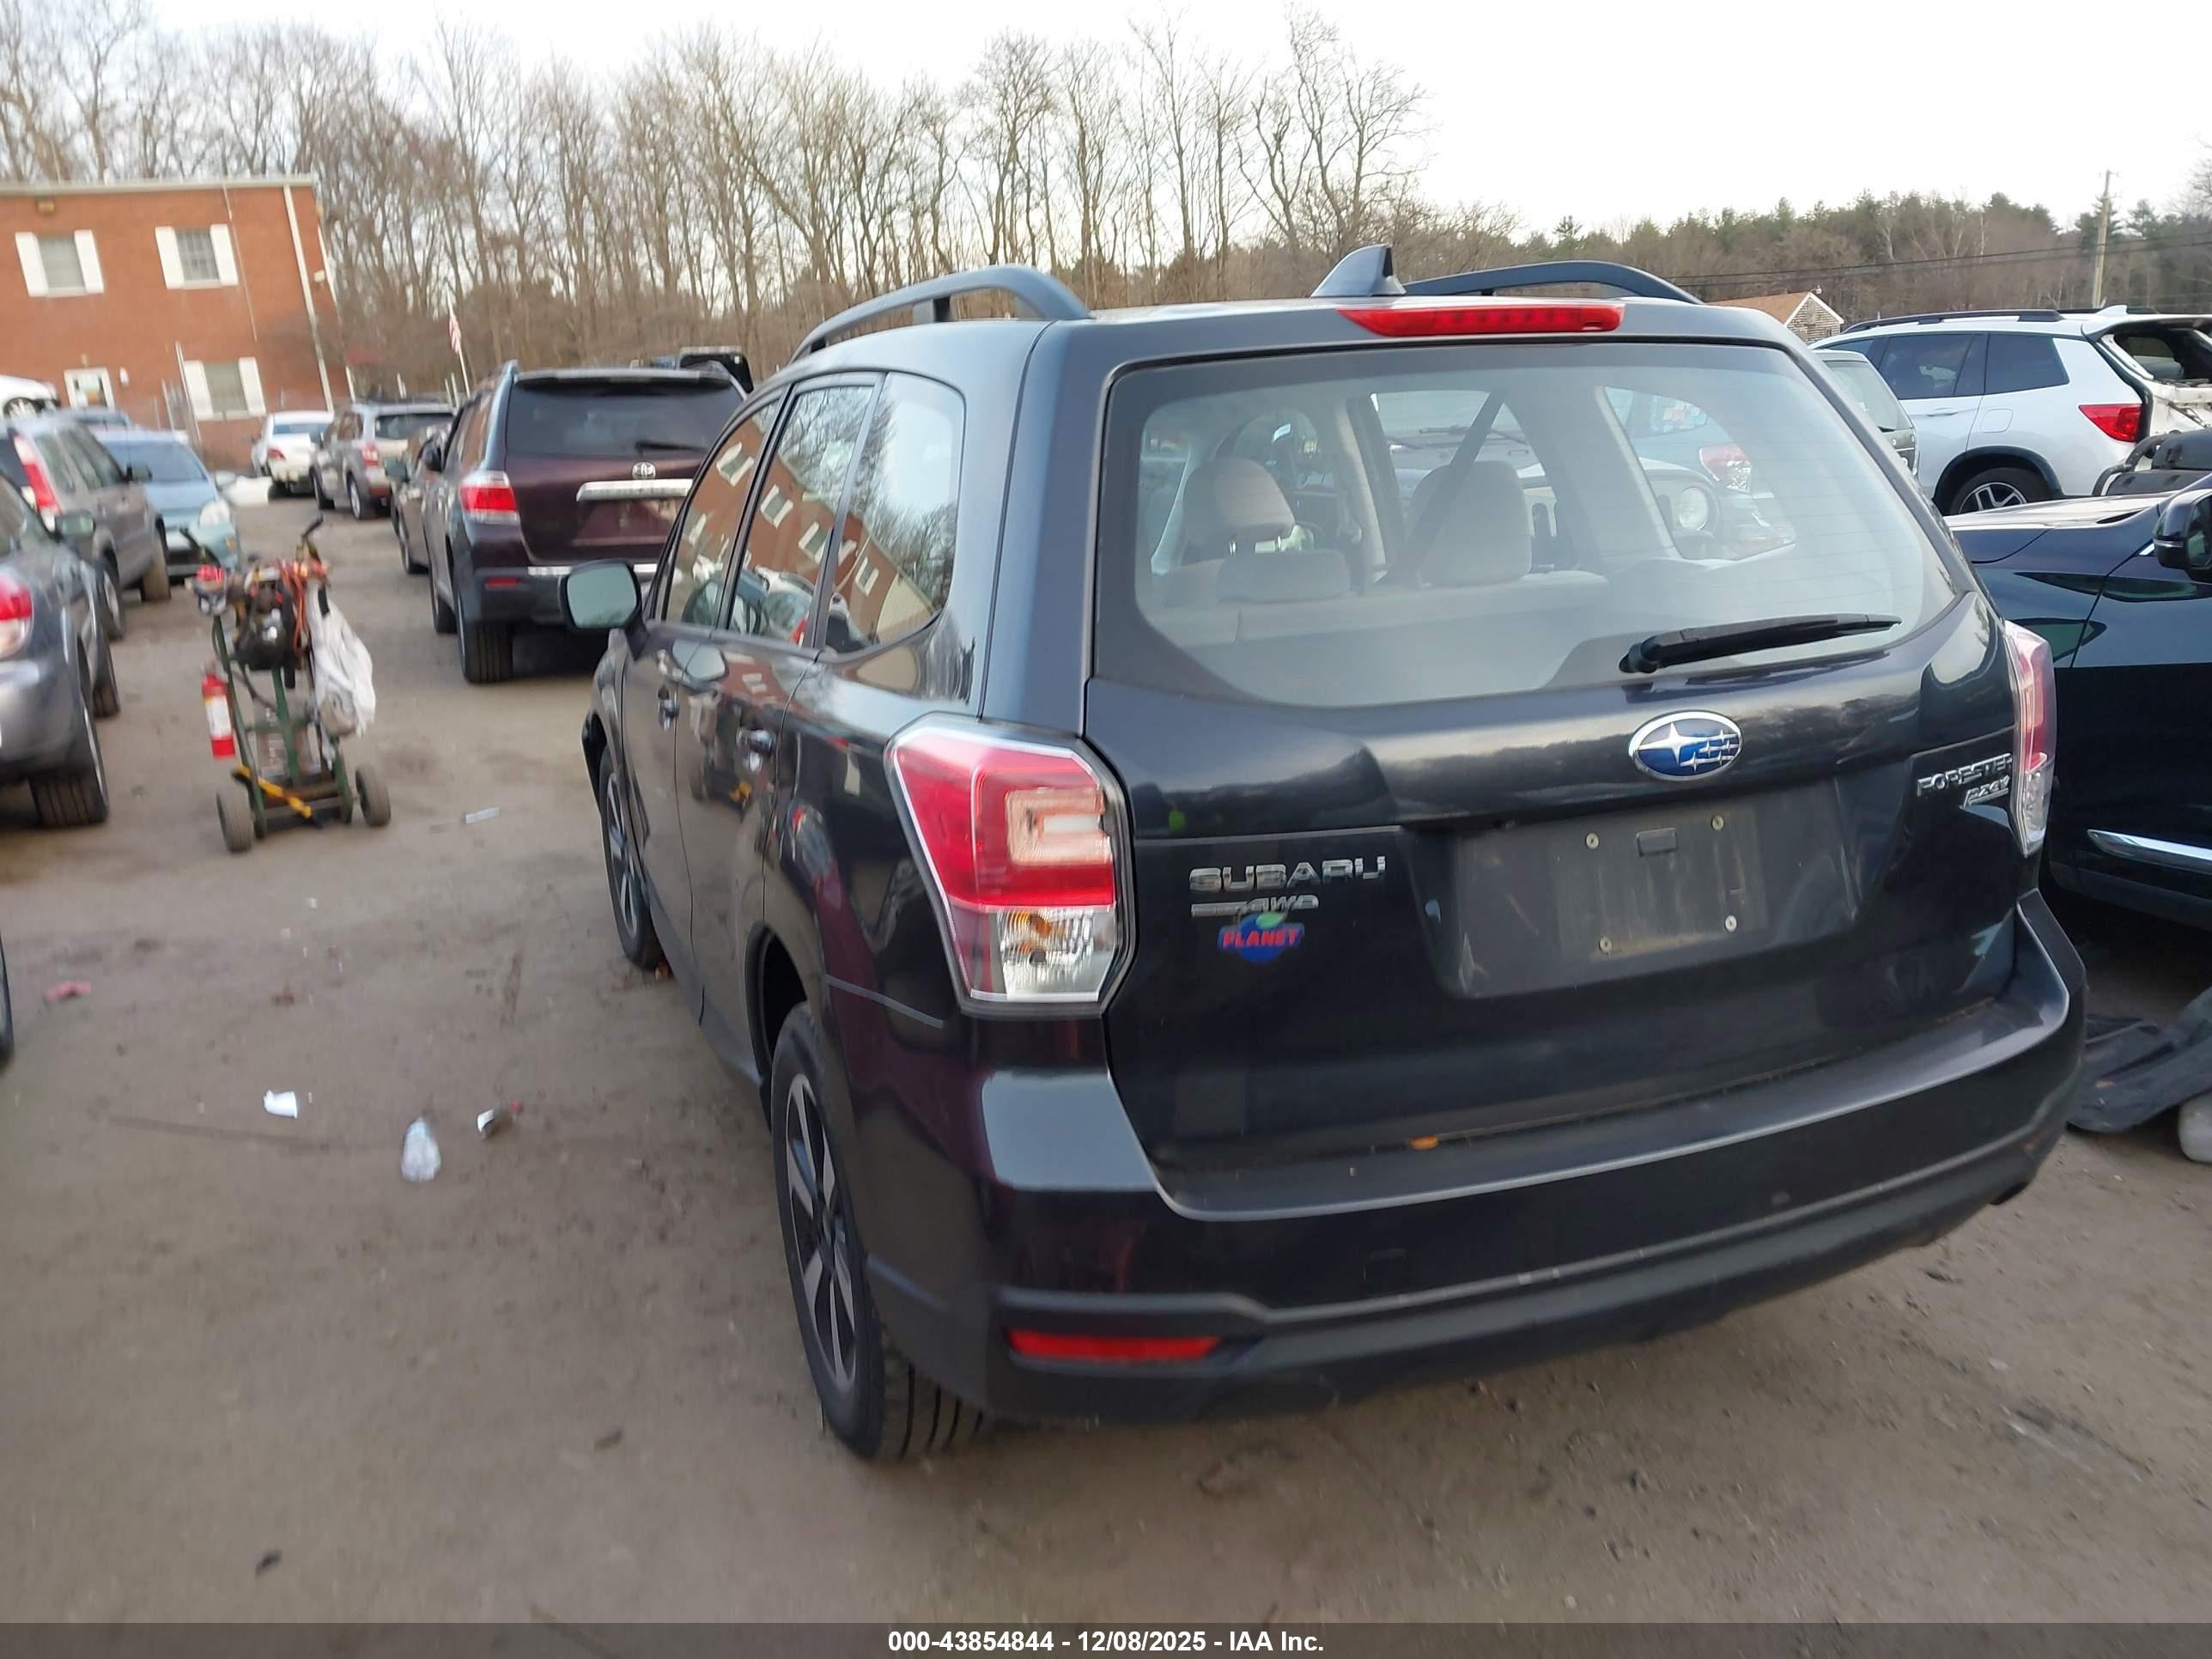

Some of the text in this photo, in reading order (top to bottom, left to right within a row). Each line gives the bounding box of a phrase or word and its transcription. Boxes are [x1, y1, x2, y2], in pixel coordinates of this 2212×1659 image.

[1917, 752, 2013, 797] FORESTER
[1188, 855, 1387, 891] SUBARU
[1221, 928, 1300, 949] PLANET
